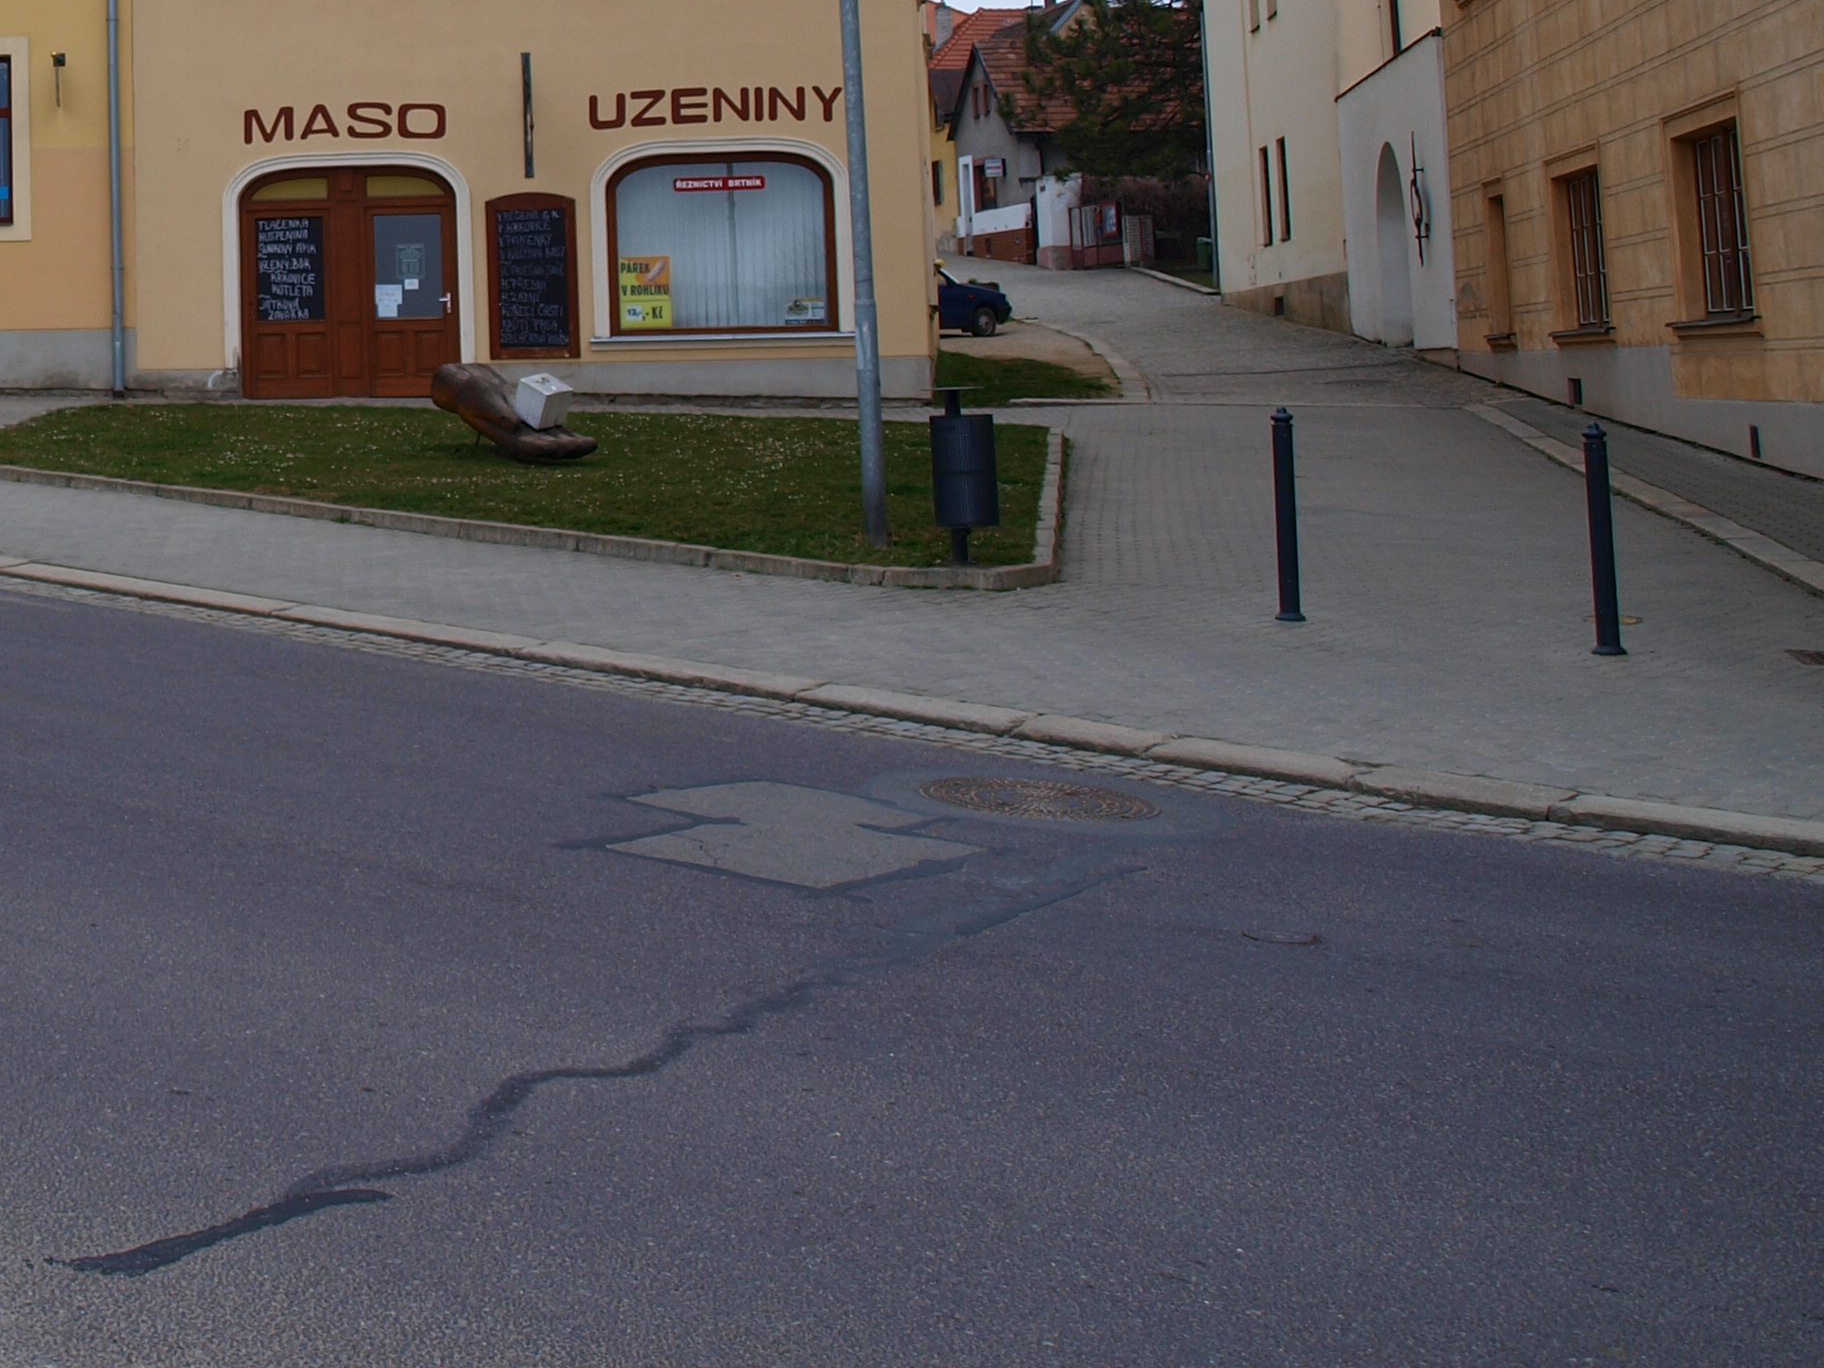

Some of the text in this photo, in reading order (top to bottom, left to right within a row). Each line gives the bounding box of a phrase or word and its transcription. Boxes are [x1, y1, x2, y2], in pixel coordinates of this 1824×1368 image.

[589, 86, 842, 130] UZENINY
[244, 102, 446, 145] MASO
[620, 260, 650, 273] PÁREK
[621, 282, 669, 296] V ROHLÍKU
